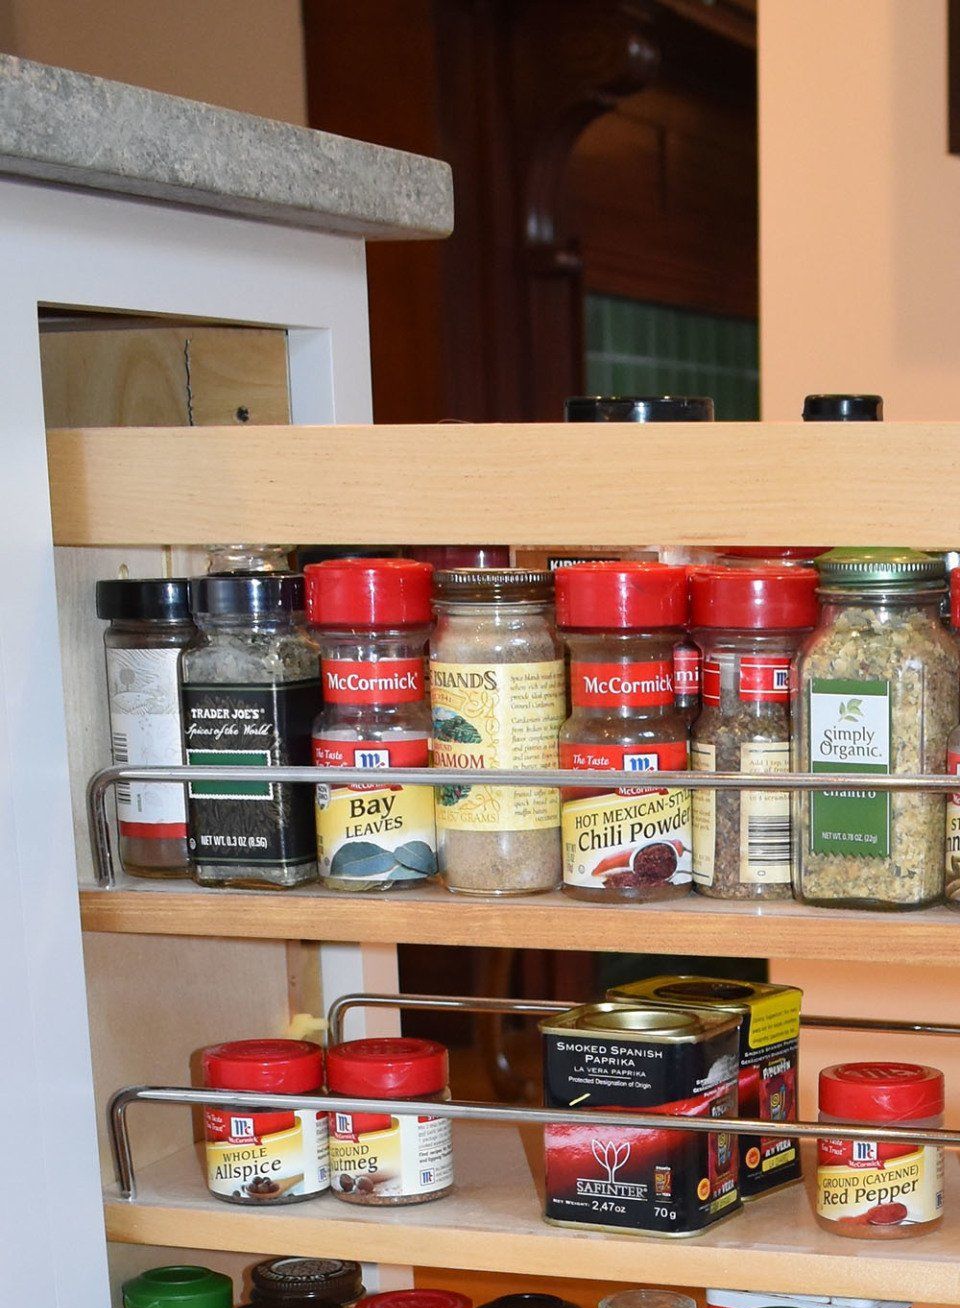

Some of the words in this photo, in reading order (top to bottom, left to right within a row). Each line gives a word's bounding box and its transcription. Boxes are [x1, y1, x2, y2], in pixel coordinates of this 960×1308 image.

[327, 672, 417, 690] McCormick
[434, 670, 497, 691] ISLANDS
[583, 675, 673, 694] McCormick
[191, 708, 230, 719] TRADER
[185, 723, 212, 739] Spices
[223, 724, 239, 735] the
[243, 724, 273, 736] World
[823, 726, 875, 745] Simply
[573, 754, 585, 765] The
[587, 755, 609, 766] Taste
[350, 795, 396, 819] Bay
[345, 816, 403, 839] LEAVES
[575, 813, 599, 829] HOT
[578, 825, 622, 852] Chili
[630, 807, 691, 843] Powder
[556, 1041, 607, 1054] SMOKED
[610, 1045, 663, 1059] SPANISH
[585, 1054, 635, 1067] PAPRIKA
[587, 1067, 608, 1075] VERA
[611, 1068, 646, 1078] PAPRIKA
[568, 1075, 594, 1085] Protected
[595, 1078, 627, 1088] Designation
[635, 1081, 652, 1090] Origin
[223, 1147, 268, 1162] WHOLE
[215, 1159, 282, 1182] Allspice
[823, 1176, 860, 1188] GROUND
[862, 1165, 919, 1188] (CAYENNE)
[576, 1181, 644, 1198] SAFINTER
[823, 1188, 848, 1205] Red
[855, 1178, 919, 1204] Pepper
